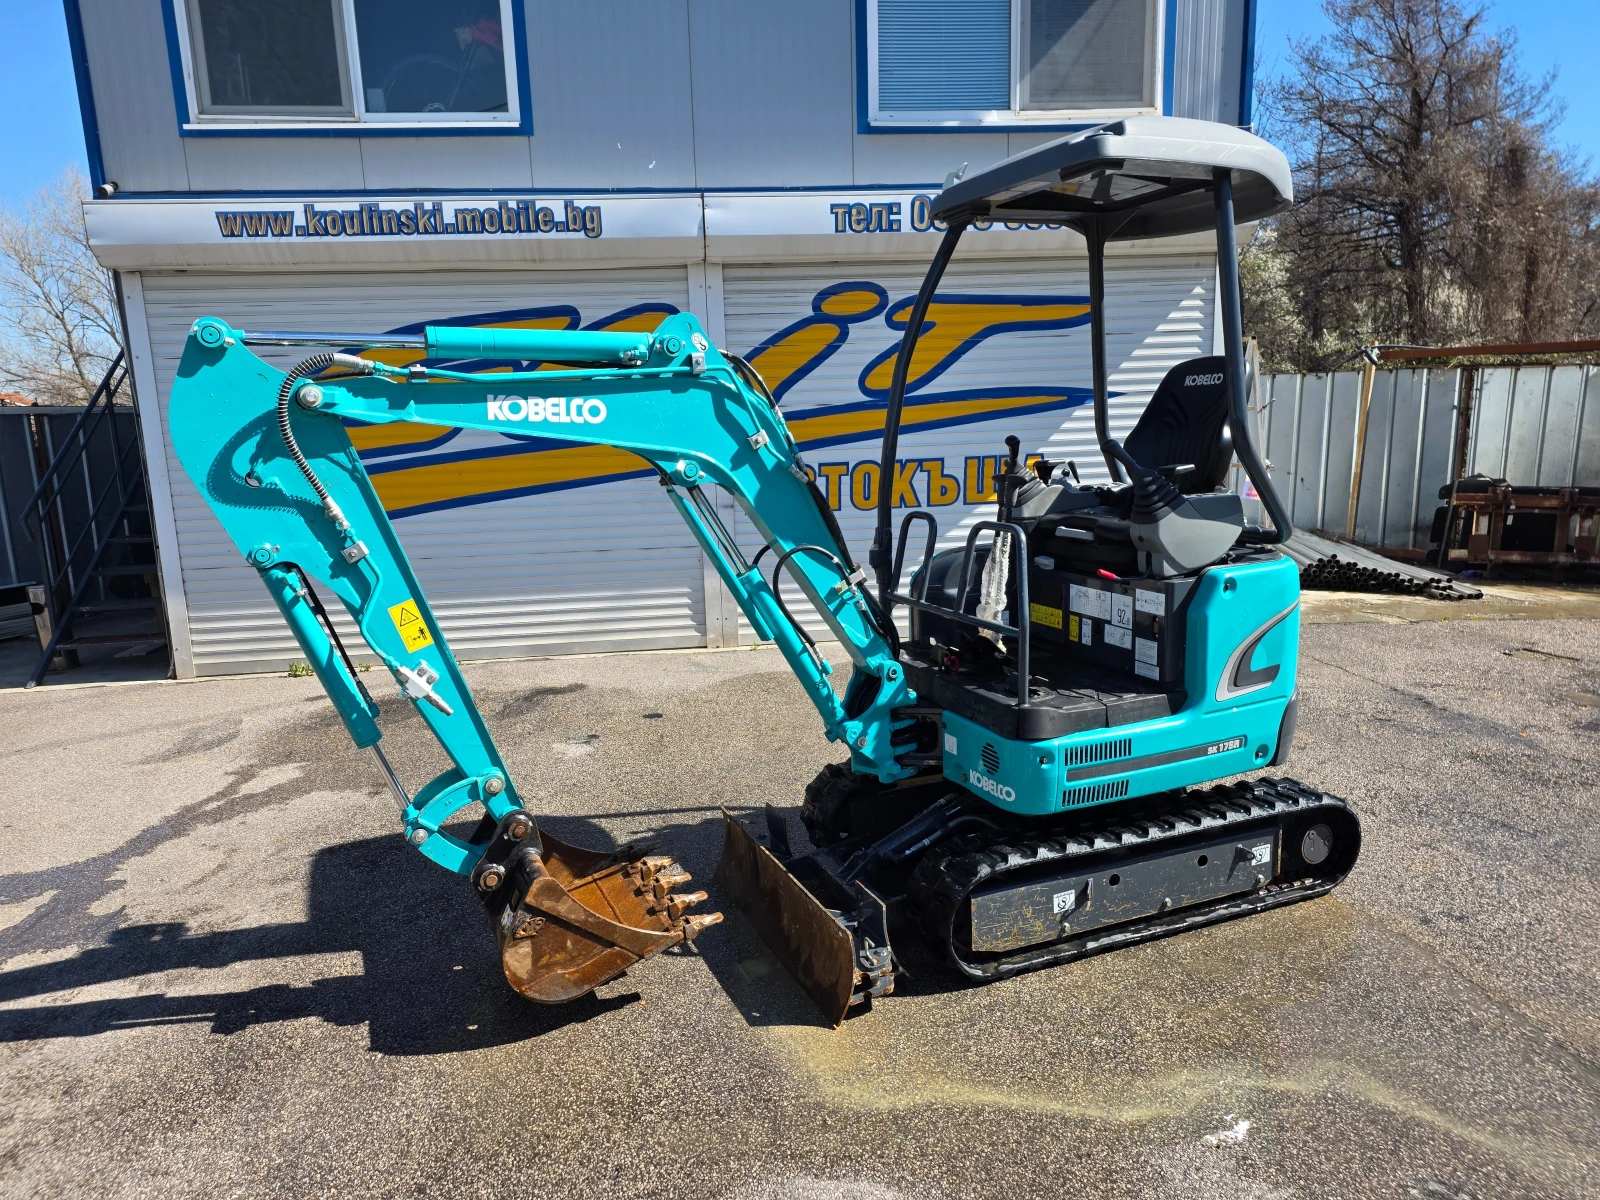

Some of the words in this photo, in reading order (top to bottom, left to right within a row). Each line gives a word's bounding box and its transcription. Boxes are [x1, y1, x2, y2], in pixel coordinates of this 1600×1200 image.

[215, 201, 602, 238] www.koulinski.mobile.bg
[830, 203, 901, 233] тел:
[1184, 373, 1224, 386] KOBELCO
[486, 394, 607, 424] KOBELCO
[1117, 608, 1126, 625] 92
[1207, 745, 1218, 754] SK
[969, 768, 1016, 802] KOBELCO
